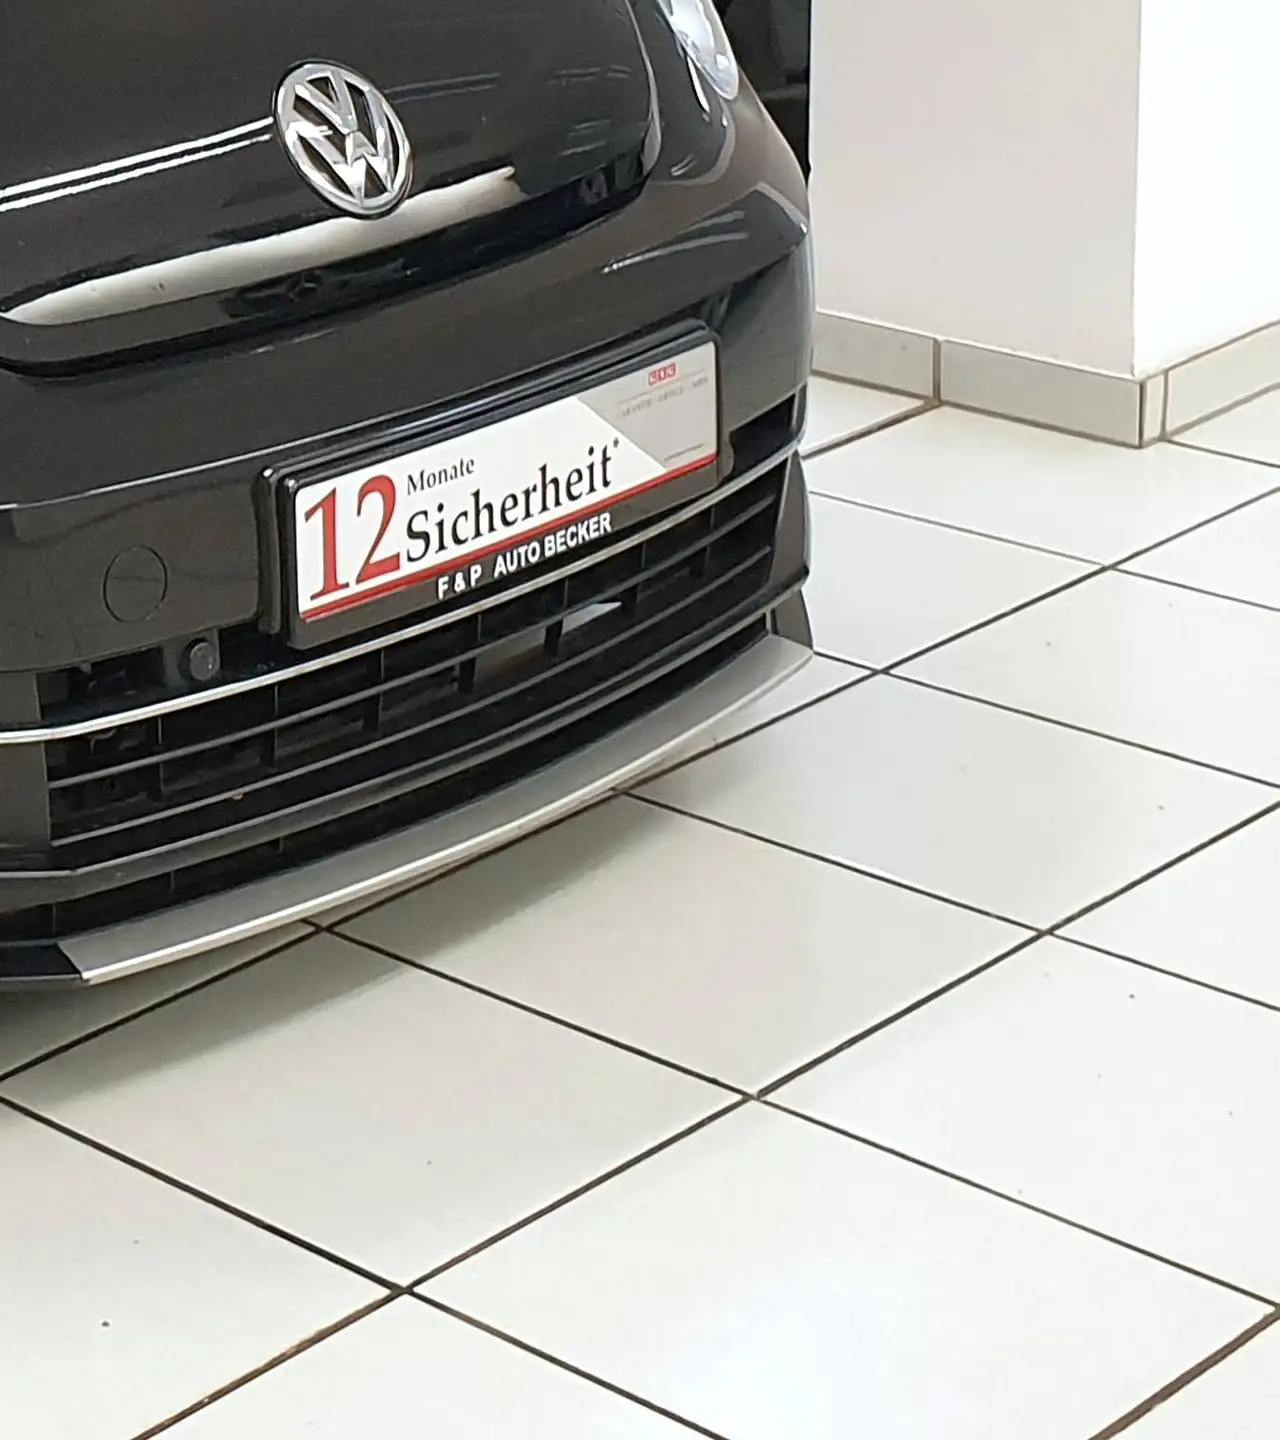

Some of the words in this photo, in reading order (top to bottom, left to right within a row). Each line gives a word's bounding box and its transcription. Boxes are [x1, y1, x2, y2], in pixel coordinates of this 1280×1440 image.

[407, 457, 475, 496] Monate
[305, 474, 400, 600] 12
[494, 541, 540, 578] AUTO
[544, 512, 612, 557] BECKER
